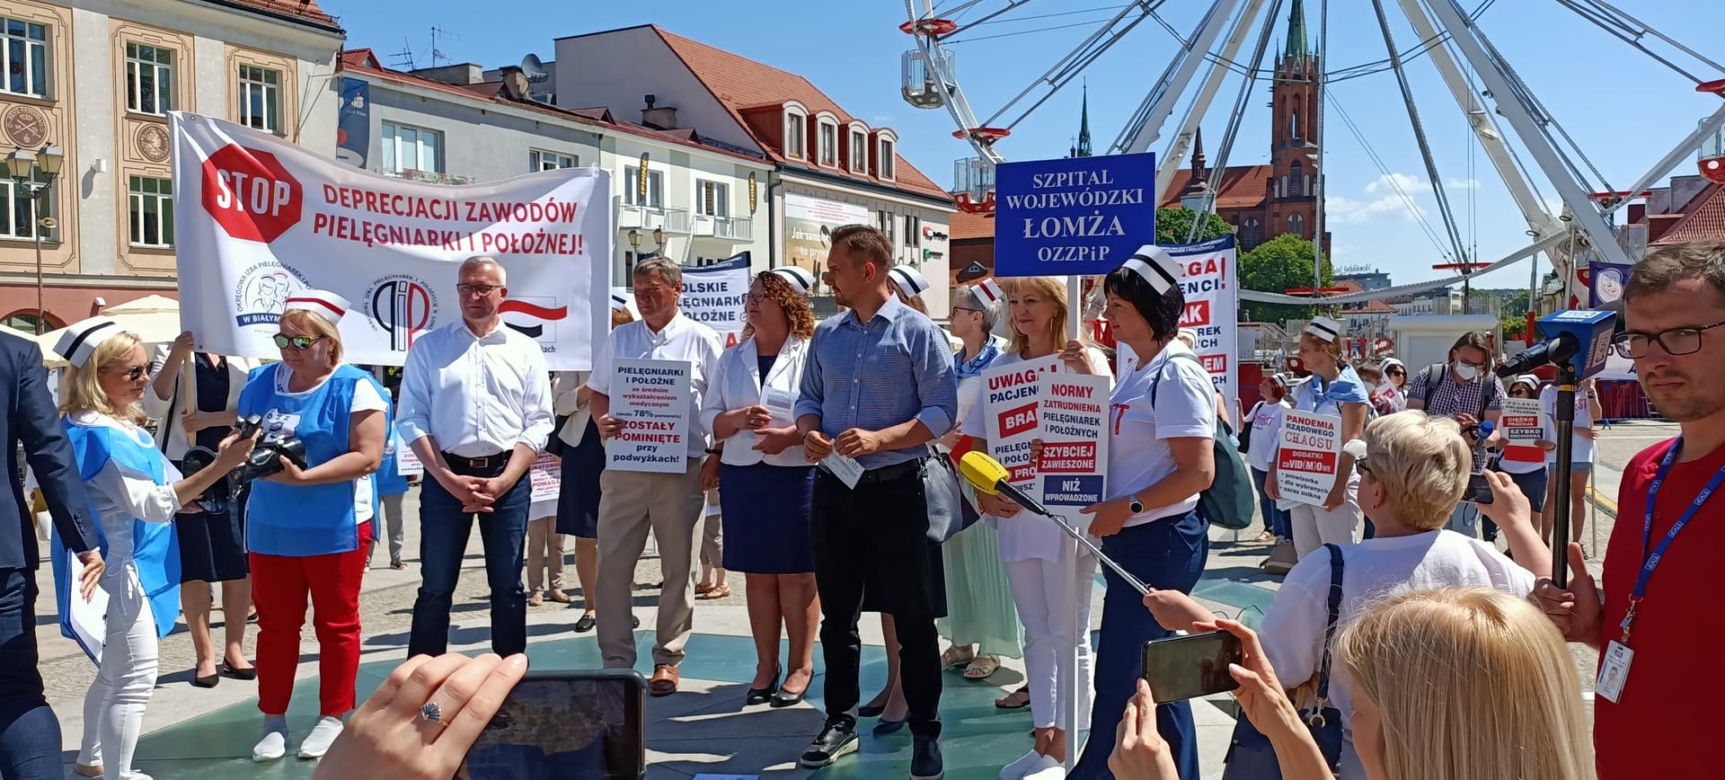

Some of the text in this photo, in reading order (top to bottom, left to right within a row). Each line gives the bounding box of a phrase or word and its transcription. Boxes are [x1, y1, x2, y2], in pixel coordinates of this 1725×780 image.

[1032, 170, 1114, 189] SZPITAL
[217, 168, 291, 217] STOP
[1006, 188, 1144, 209] WOJEWÓDZKI
[323, 184, 578, 223] DEPRECJACJI ZAWODÓW
[1023, 209, 1125, 239] ŁOMŻA
[314, 213, 583, 255] PIELĘGNIARKI I POŁOŻNEJ!
[1037, 246, 1110, 262] OZZPiP
[681, 282, 728, 293] OLSKIE
[243, 314, 279, 323] W BIAŁYM
[683, 310, 736, 322] OŁOŻNE
[617, 366, 684, 377] PIELĘGNIARKI
[988, 366, 1044, 391] UWAG
[631, 376, 676, 386] POŁOŻNE
[989, 385, 1039, 404] PACJEN
[1051, 384, 1094, 399] NORMY
[633, 409, 654, 418] 78%
[1043, 399, 1101, 414] ZATRUDNIENIA
[623, 420, 676, 431] ZOSTAŁY
[1005, 407, 1037, 430] BRA
[1043, 411, 1100, 426] PIELĘGNIAREK
[1286, 415, 1335, 430] PANDEMIA
[614, 432, 681, 444] POMINIĘTE
[1049, 424, 1098, 438] POŁOŻNYCH
[1286, 423, 1335, 438] RZĄDOWEGO
[1285, 431, 1333, 450] CHAOSU
[636, 444, 658, 453] przy
[1043, 446, 1094, 458] SZYBCIEJ
[613, 453, 680, 463] podwyżkach!
[1041, 459, 1094, 469] ZAWIESZONE
[1062, 477, 1081, 492] NIŻ
[1045, 493, 1098, 502] WPROWADZONE
